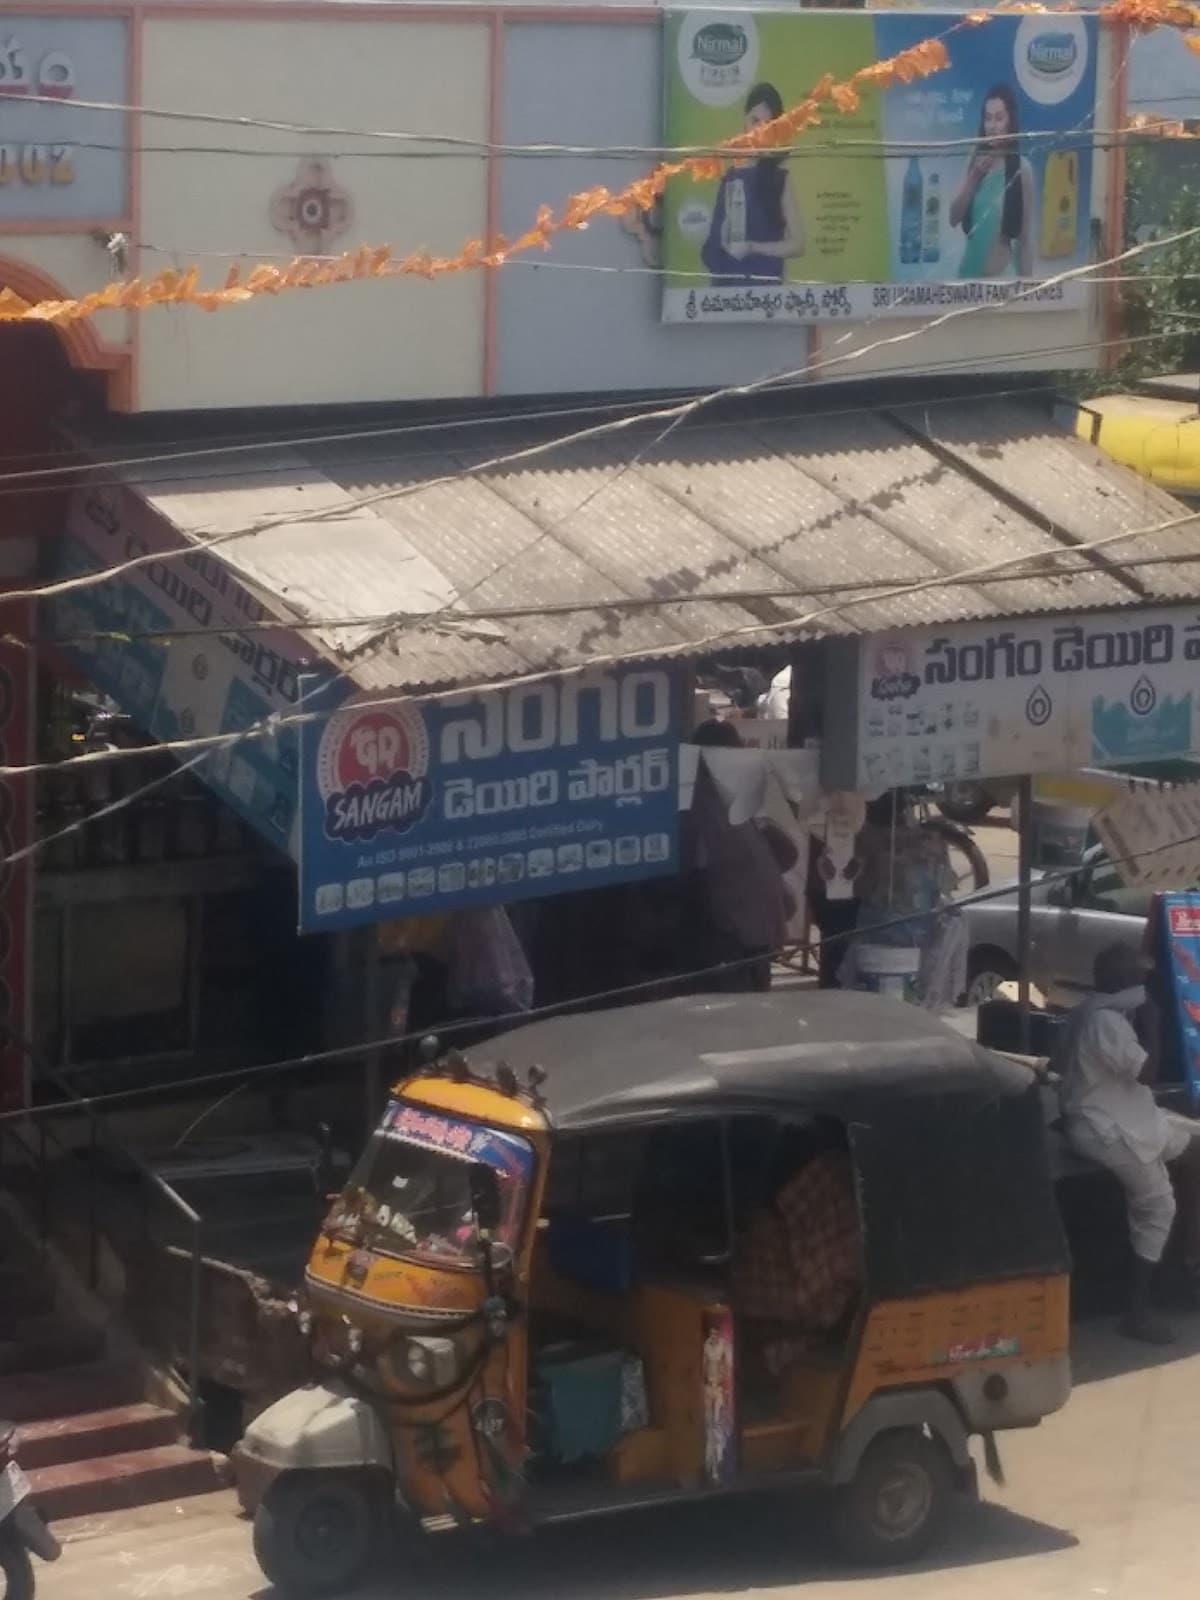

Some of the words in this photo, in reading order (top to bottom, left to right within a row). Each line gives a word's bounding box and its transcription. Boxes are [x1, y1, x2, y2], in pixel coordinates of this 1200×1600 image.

[697, 34, 747, 55] Nirmal
[1030, 43, 1075, 62] Nirmal
[924, 632, 1043, 684] సంగం
[1052, 624, 1174, 672] డెయిరి
[333, 782, 423, 831] SANGAM
[444, 769, 560, 819] డెయిరి
